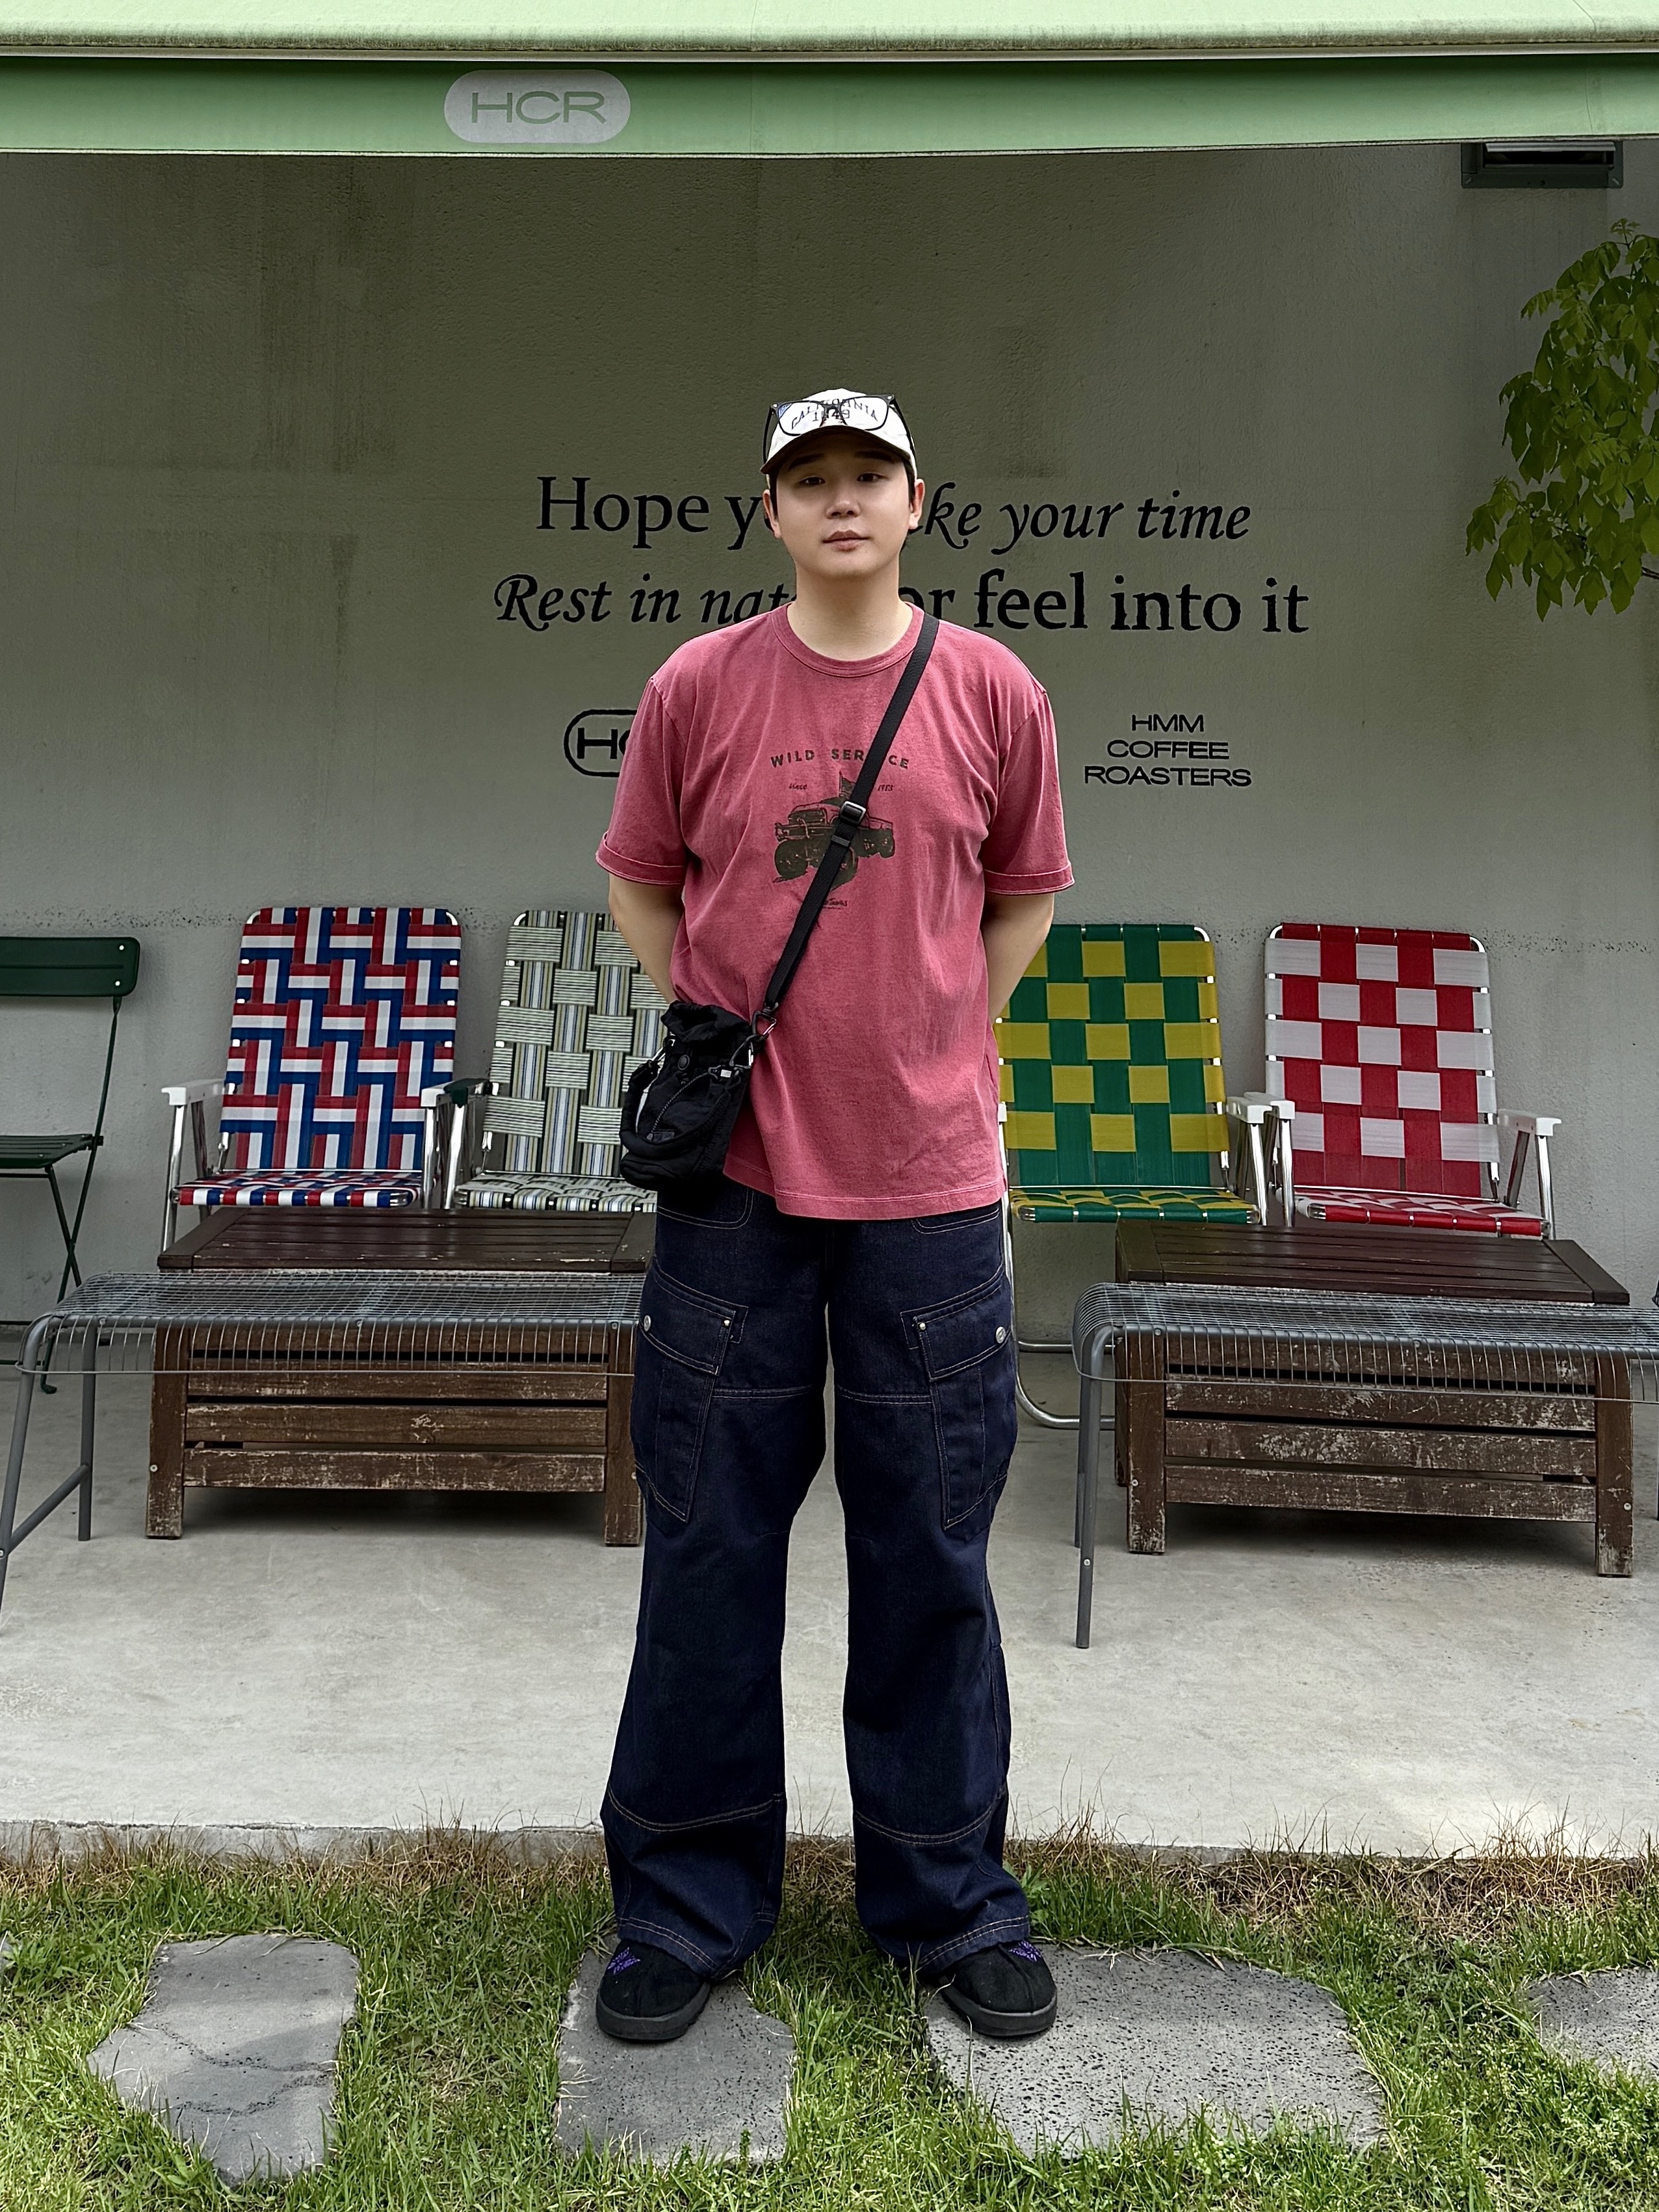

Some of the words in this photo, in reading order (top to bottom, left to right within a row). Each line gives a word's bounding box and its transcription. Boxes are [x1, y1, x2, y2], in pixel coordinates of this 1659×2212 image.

[471, 90, 606, 124] HCR
[536, 476, 709, 549] Hope
[908, 482, 982, 549] ke
[991, 501, 1125, 555] your
[1137, 490, 1251, 540] time
[494, 573, 612, 631] Rest
[630, 573, 681, 623] in
[699, 584, 797, 625] nat
[974, 568, 1089, 629] feel
[1110, 575, 1242, 633] into
[1262, 577, 1309, 633] it
[1132, 713, 1205, 733] HMM
[770, 750, 815, 768] WILD
[831, 748, 909, 769] SERCE
[1107, 739, 1229, 759] COFFEE
[1084, 765, 1252, 787] ROASTERS
